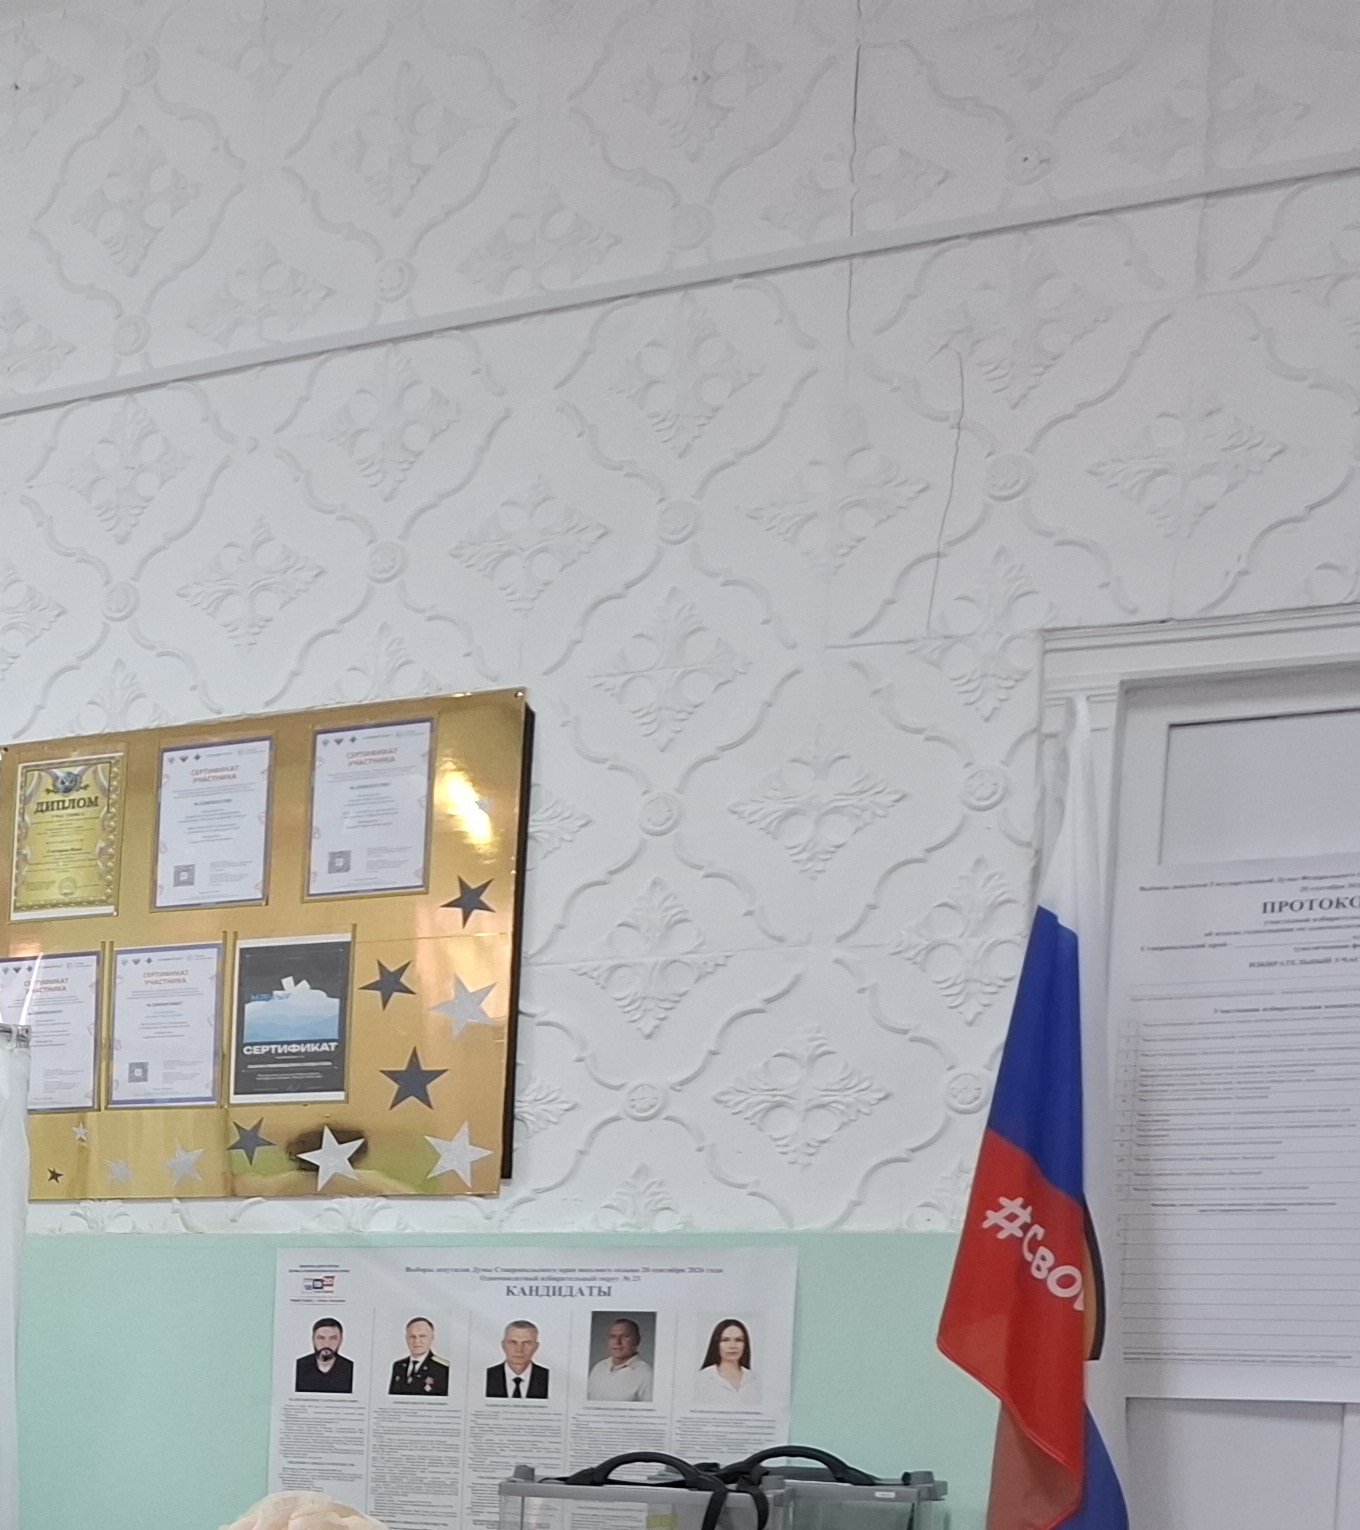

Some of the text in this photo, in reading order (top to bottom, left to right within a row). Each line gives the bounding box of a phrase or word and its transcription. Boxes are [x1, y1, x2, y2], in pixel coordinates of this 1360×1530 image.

[34, 796, 99, 814] ДИПЛОМ
[242, 1041, 339, 1055] СЕРТИФИКАТ
[505, 1285, 612, 1297] КАНДИДАТЫ
